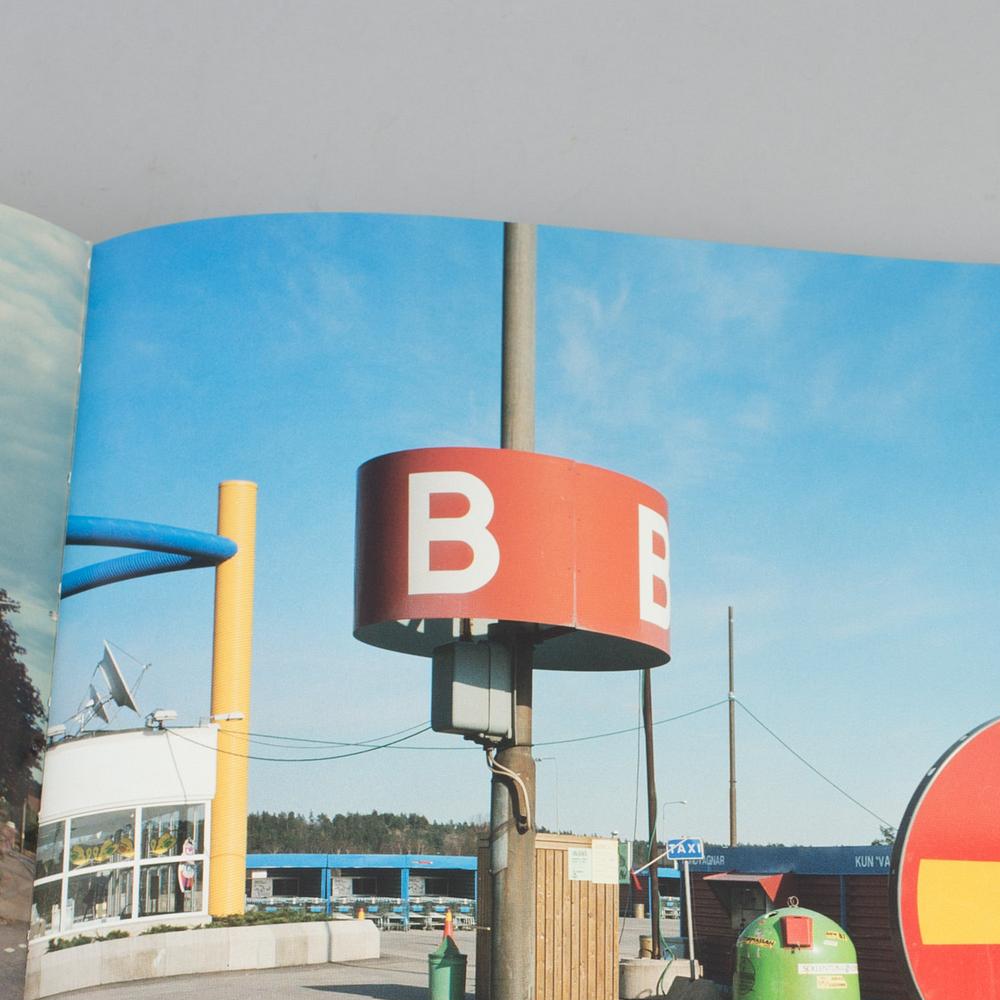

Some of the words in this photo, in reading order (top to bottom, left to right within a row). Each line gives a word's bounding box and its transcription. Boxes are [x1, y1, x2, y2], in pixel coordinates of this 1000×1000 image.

[408, 471, 500, 596] B
[638, 503, 671, 630] B
[669, 843, 701, 854] TAXI
